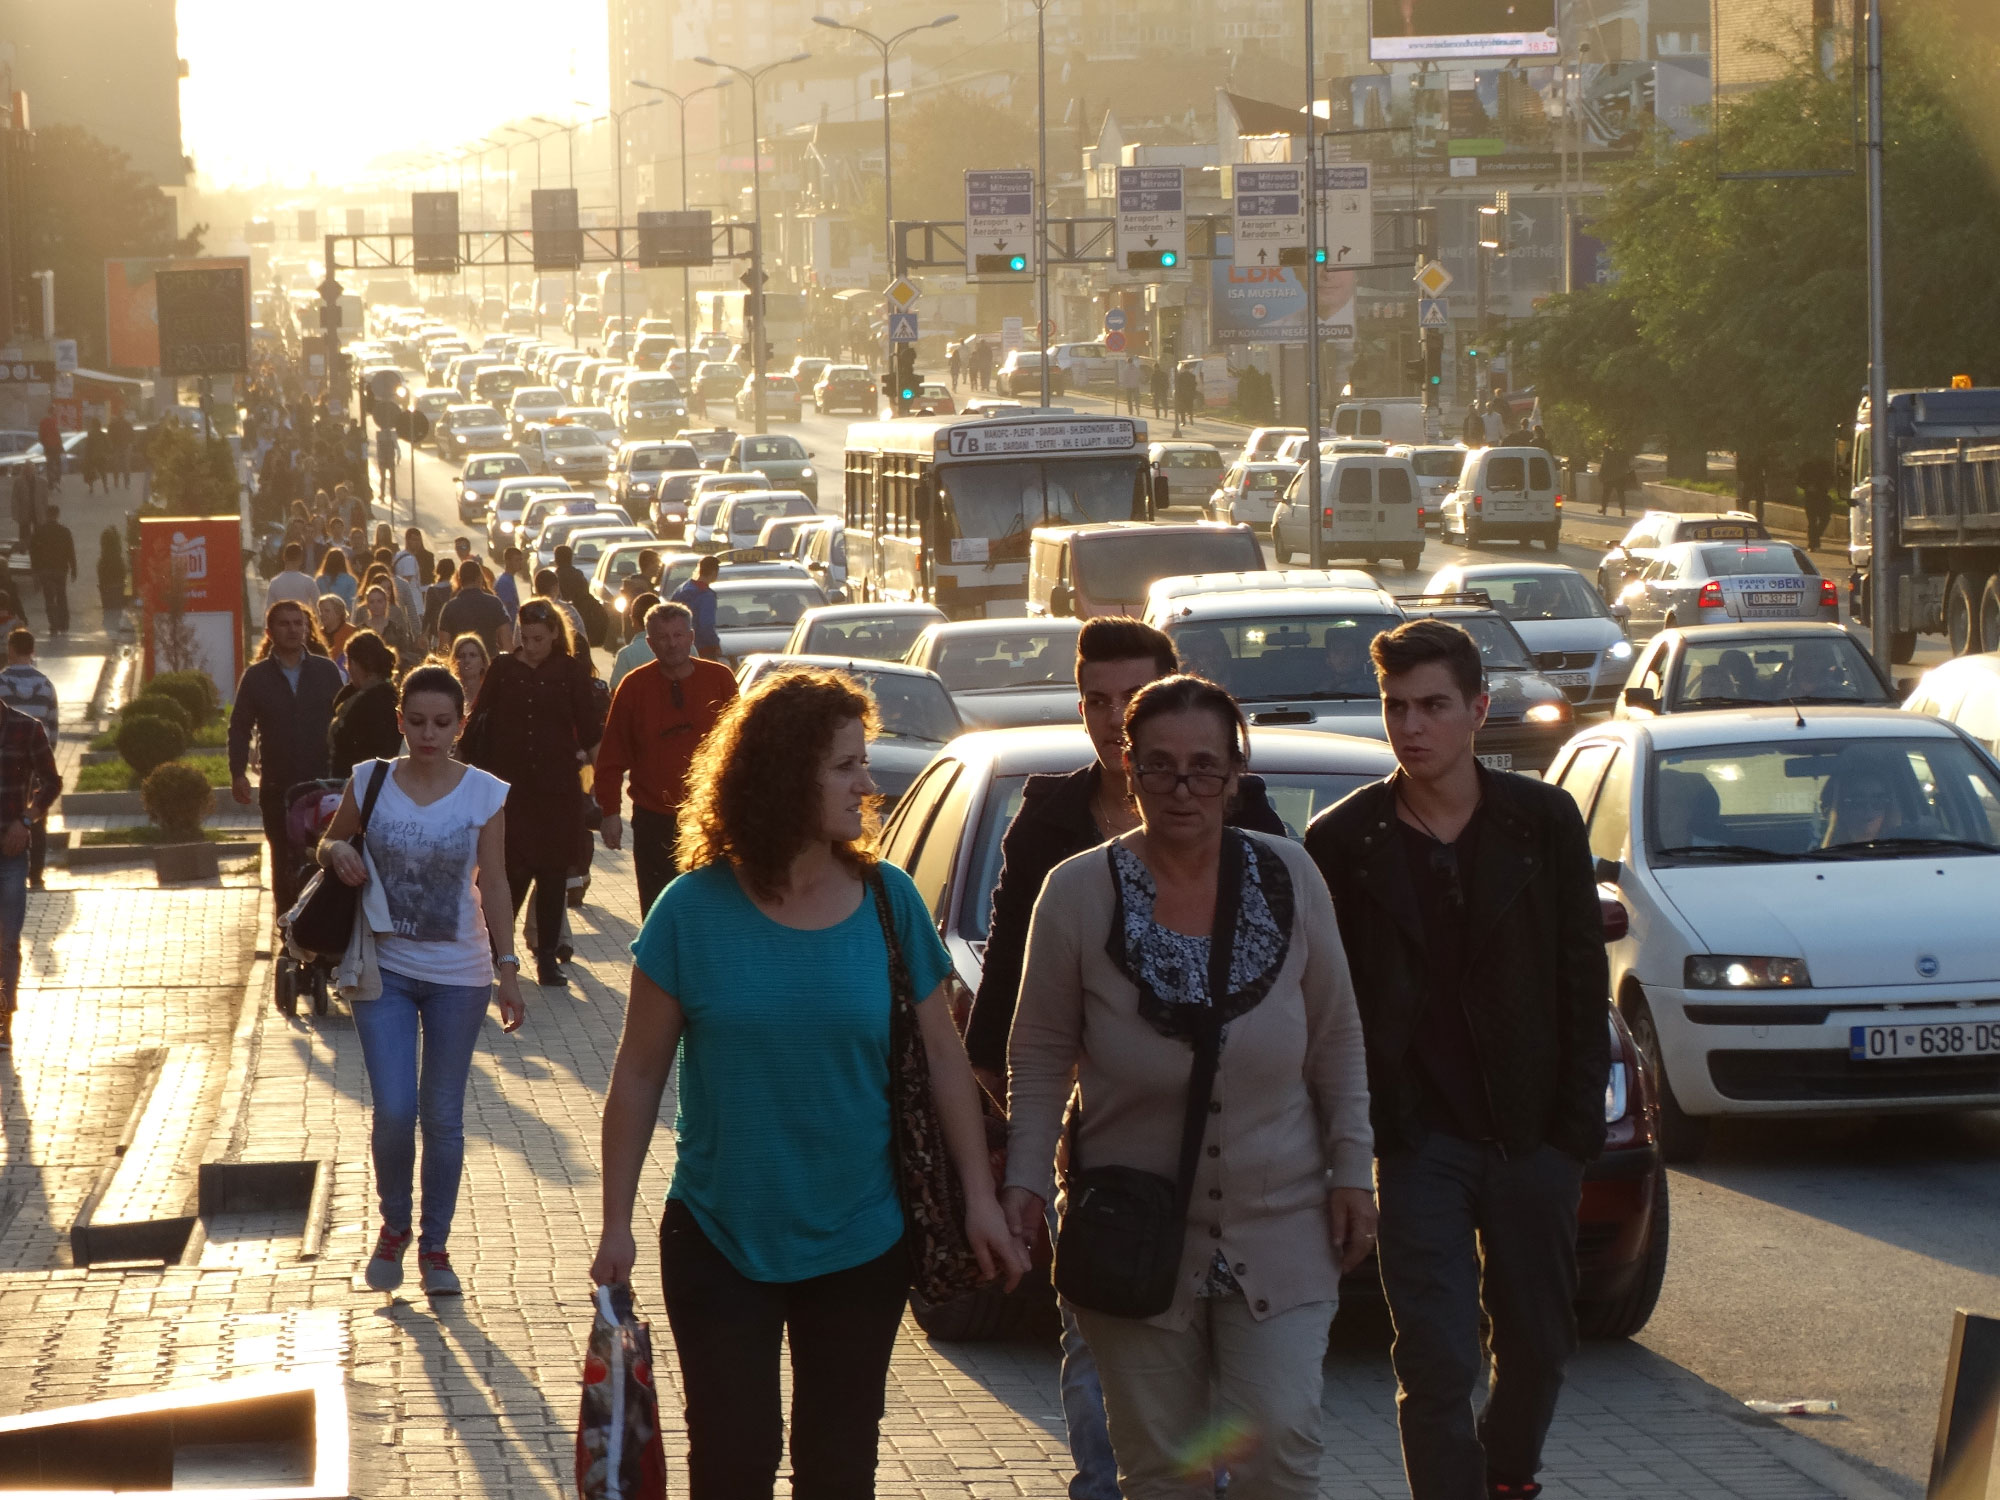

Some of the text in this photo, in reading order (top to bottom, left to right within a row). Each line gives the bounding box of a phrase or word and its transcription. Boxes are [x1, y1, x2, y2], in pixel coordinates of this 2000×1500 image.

[973, 219, 1009, 227] Aeroport
[1123, 215, 1160, 223] Aeroport
[1123, 224, 1164, 232] Aerodrom
[1241, 221, 1277, 230] Aeroport
[973, 228, 1013, 236] Aerodrom
[1241, 230, 1281, 239] Aerodrom
[1228, 264, 1287, 283] LDK
[1228, 287, 1298, 299] ISA MUSTAFA
[1218, 329, 1236, 338] SOT
[1318, 327, 1350, 336] OSOVA
[953, 431, 979, 453] 7B
[1778, 578, 1805, 589] BEKI
[1870, 1028, 1898, 1056] 01
